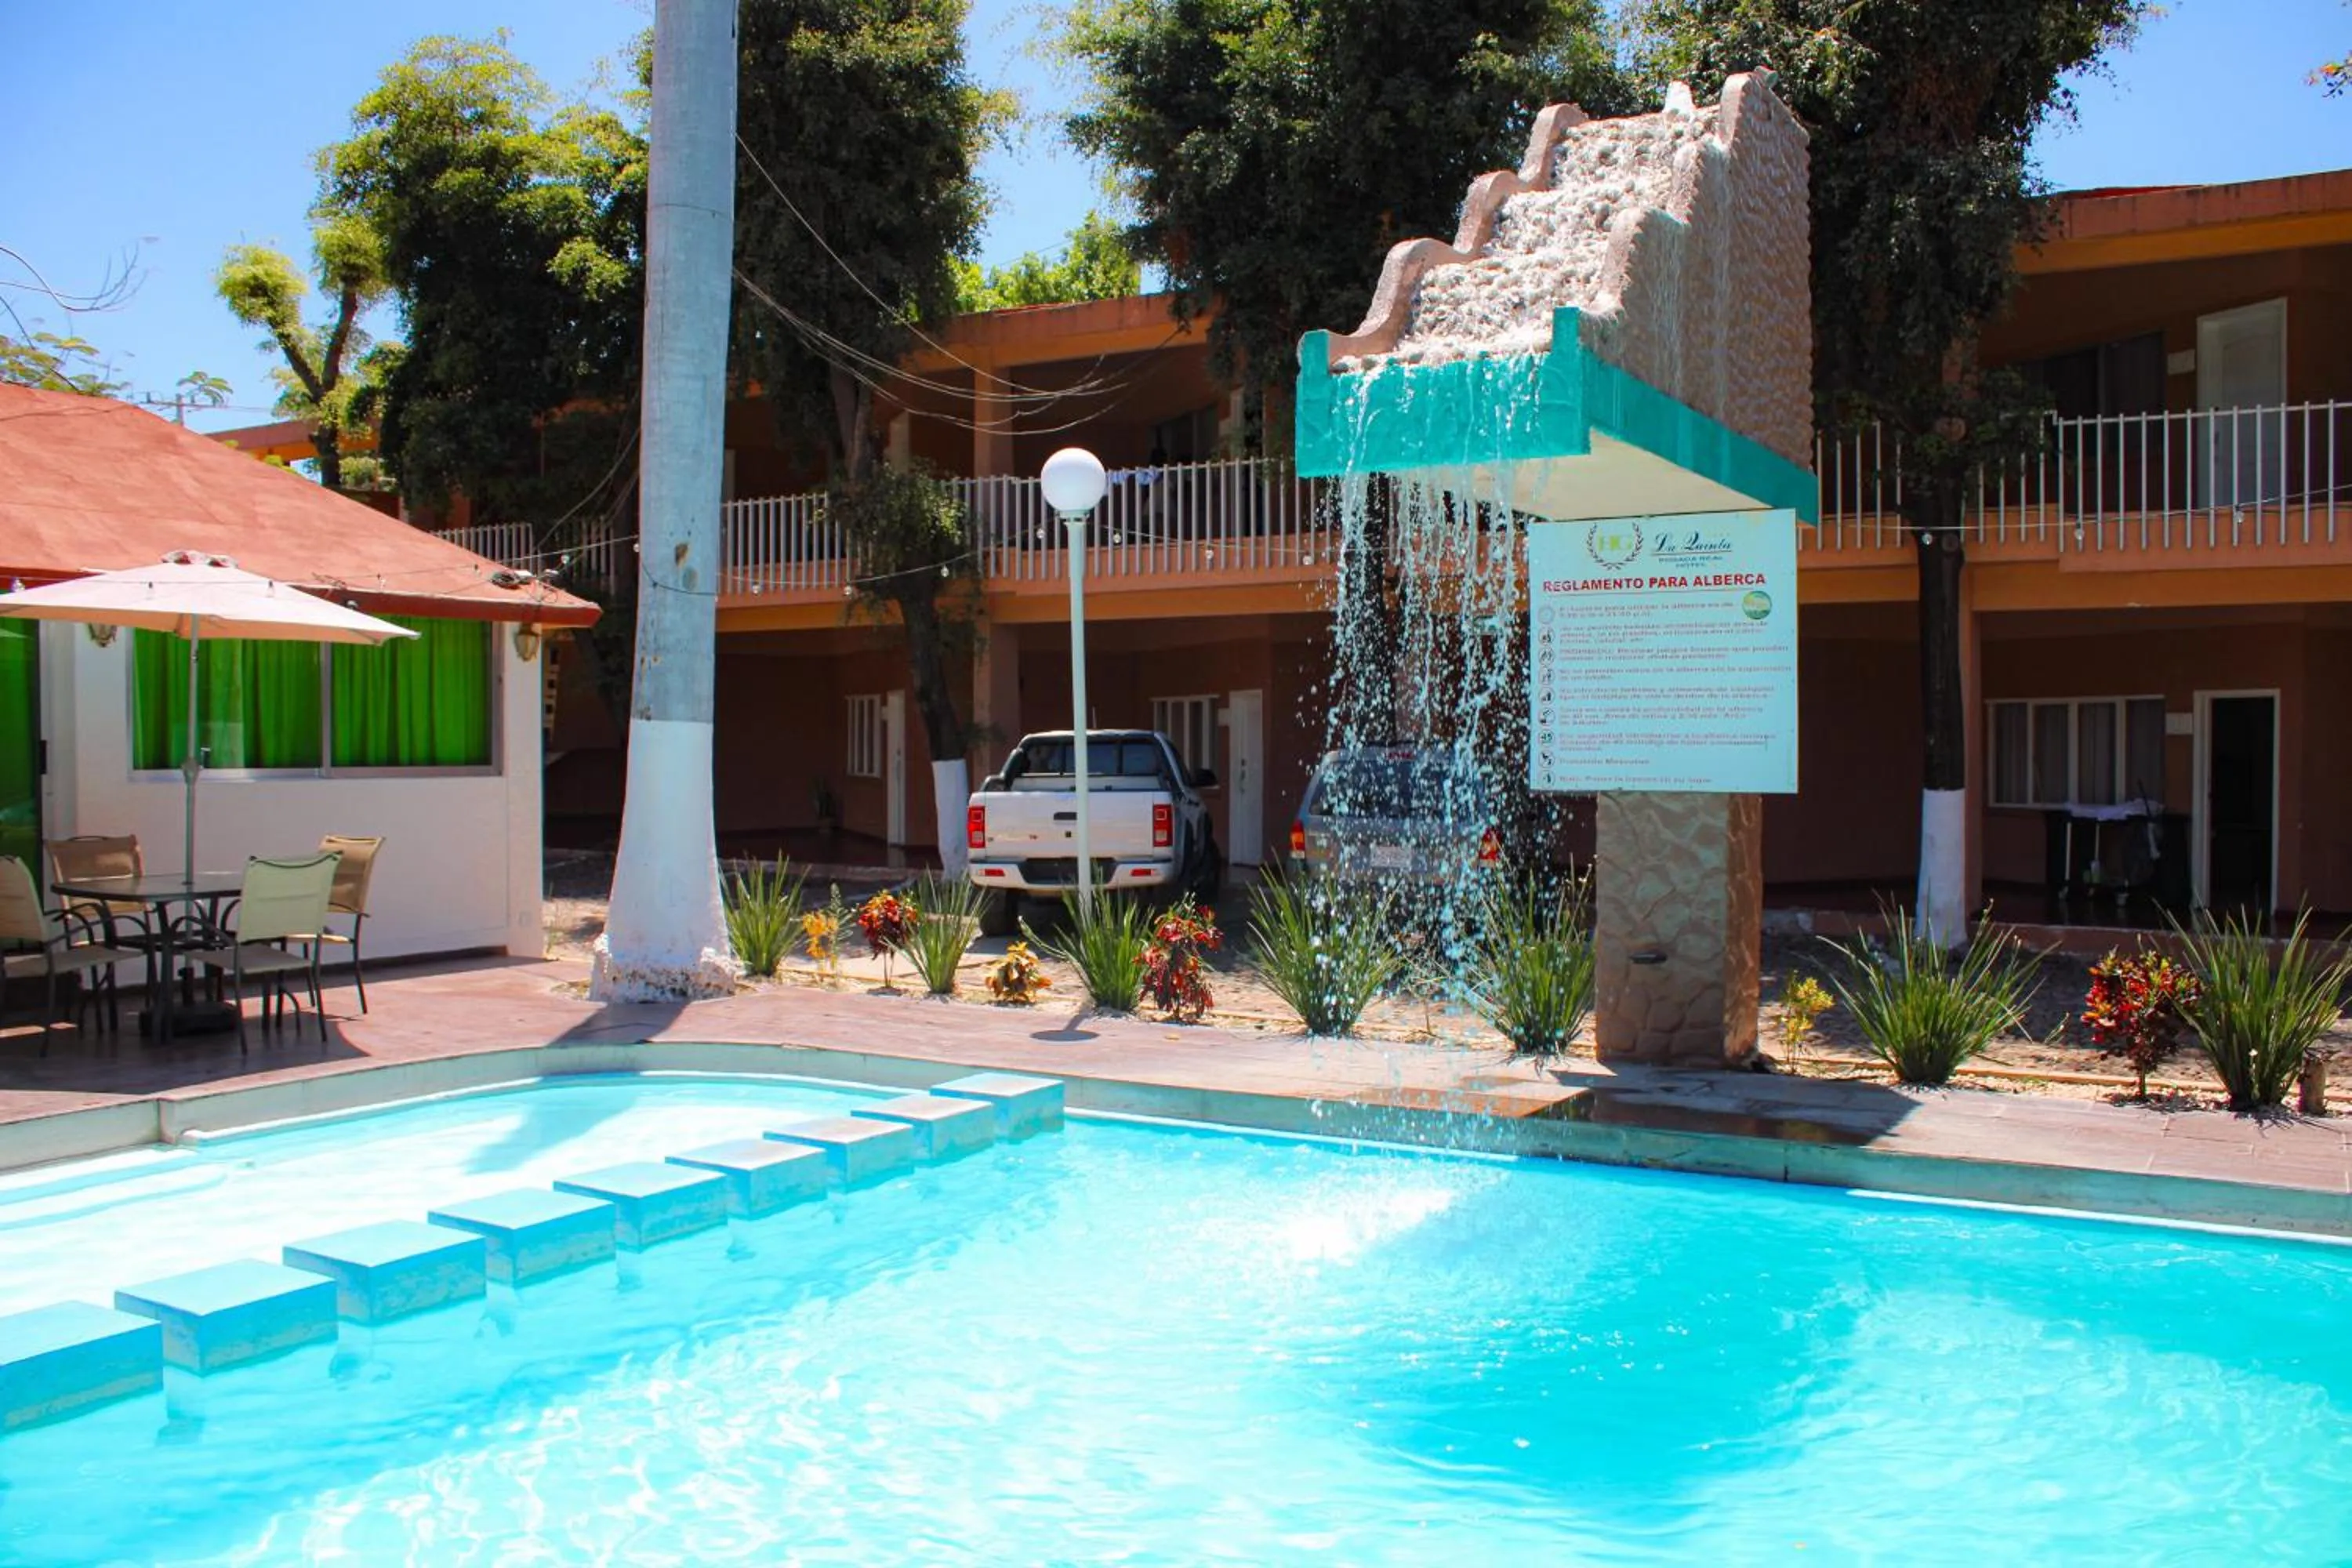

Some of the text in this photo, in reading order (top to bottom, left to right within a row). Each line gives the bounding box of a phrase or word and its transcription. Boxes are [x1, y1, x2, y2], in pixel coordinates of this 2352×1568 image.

[1655, 529, 1732, 552] La Quinta
[1543, 573, 1766, 593] REGLAMENTO PARA ALBERCA
